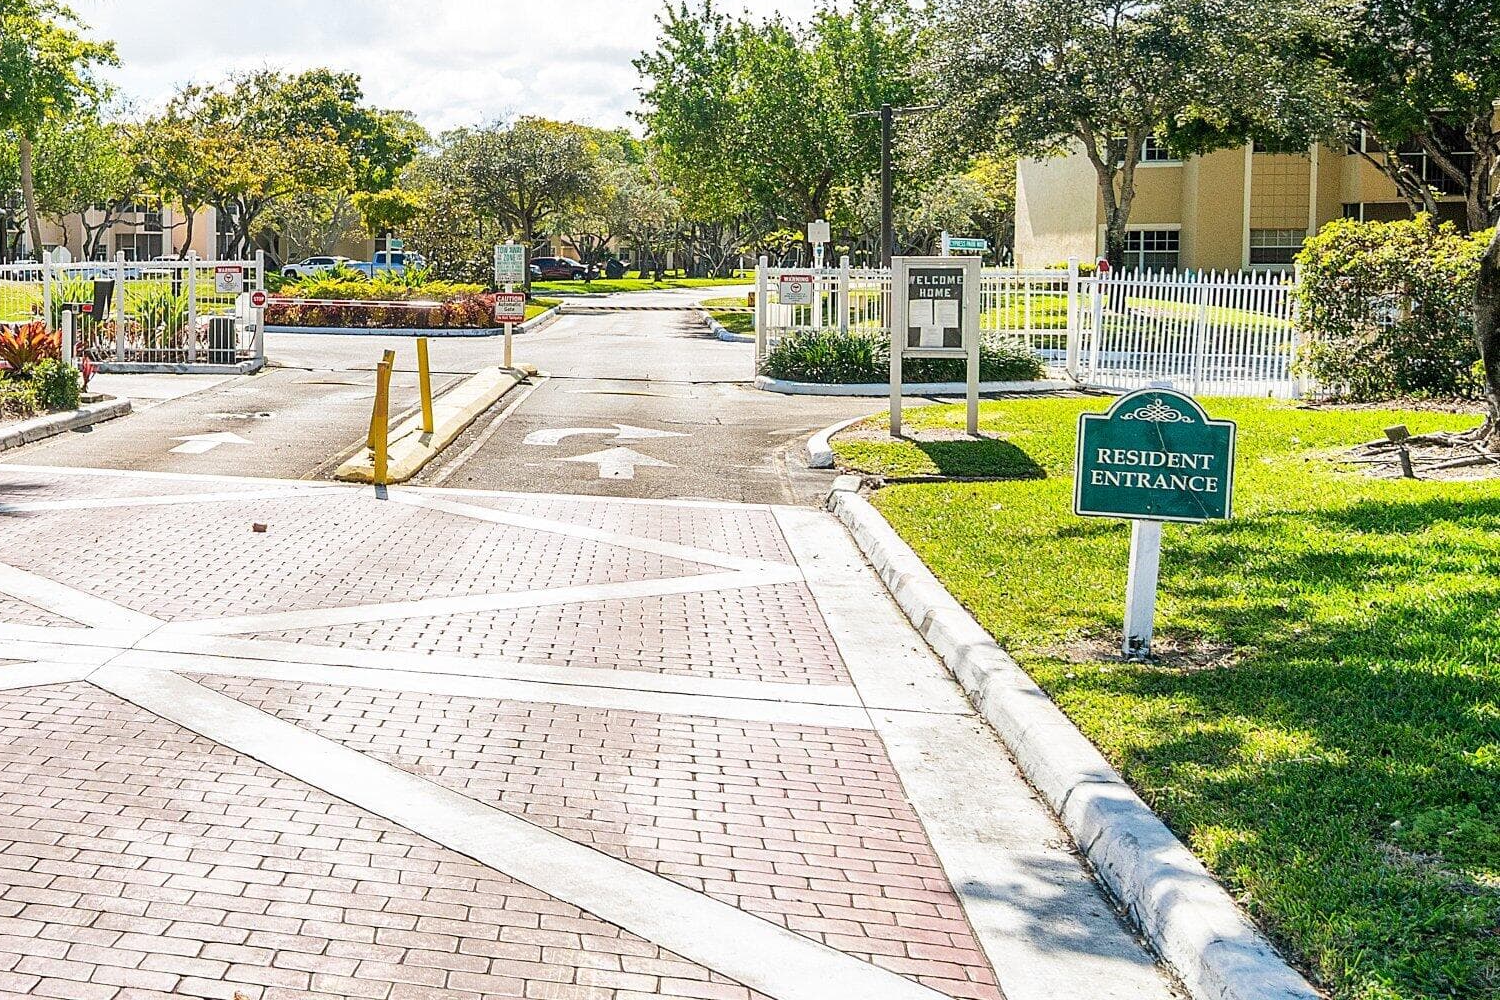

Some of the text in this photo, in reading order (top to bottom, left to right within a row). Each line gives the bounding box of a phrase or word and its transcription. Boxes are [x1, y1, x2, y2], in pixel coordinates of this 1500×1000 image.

[503, 253, 516, 261] ZONE
[909, 275, 963, 284] WELCOME
[920, 288, 951, 297] HOME
[1097, 448, 1215, 470] RESIDENT
[1091, 470, 1219, 493] ENTRANCE
